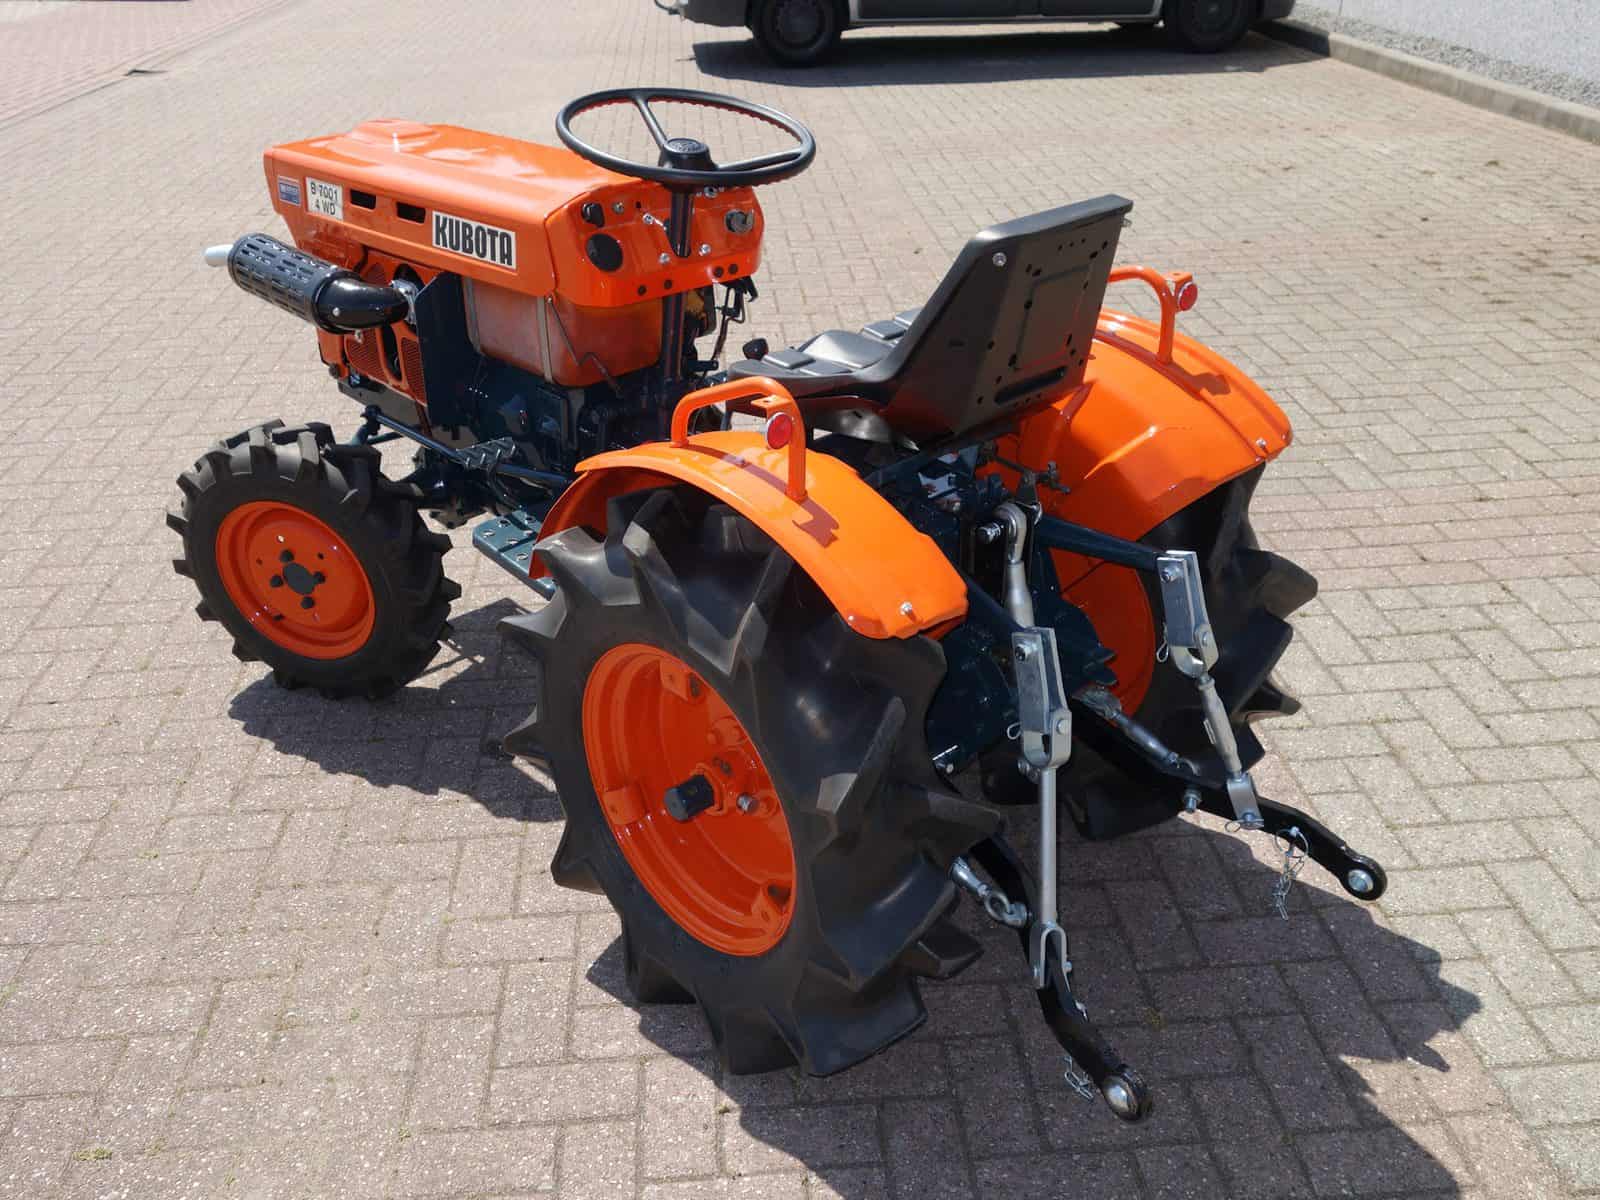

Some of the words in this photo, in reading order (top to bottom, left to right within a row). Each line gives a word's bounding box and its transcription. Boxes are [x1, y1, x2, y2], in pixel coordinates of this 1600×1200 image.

[319, 184, 338, 202] 7001
[322, 200, 336, 215] WD
[435, 214, 512, 266] KUBOTA
